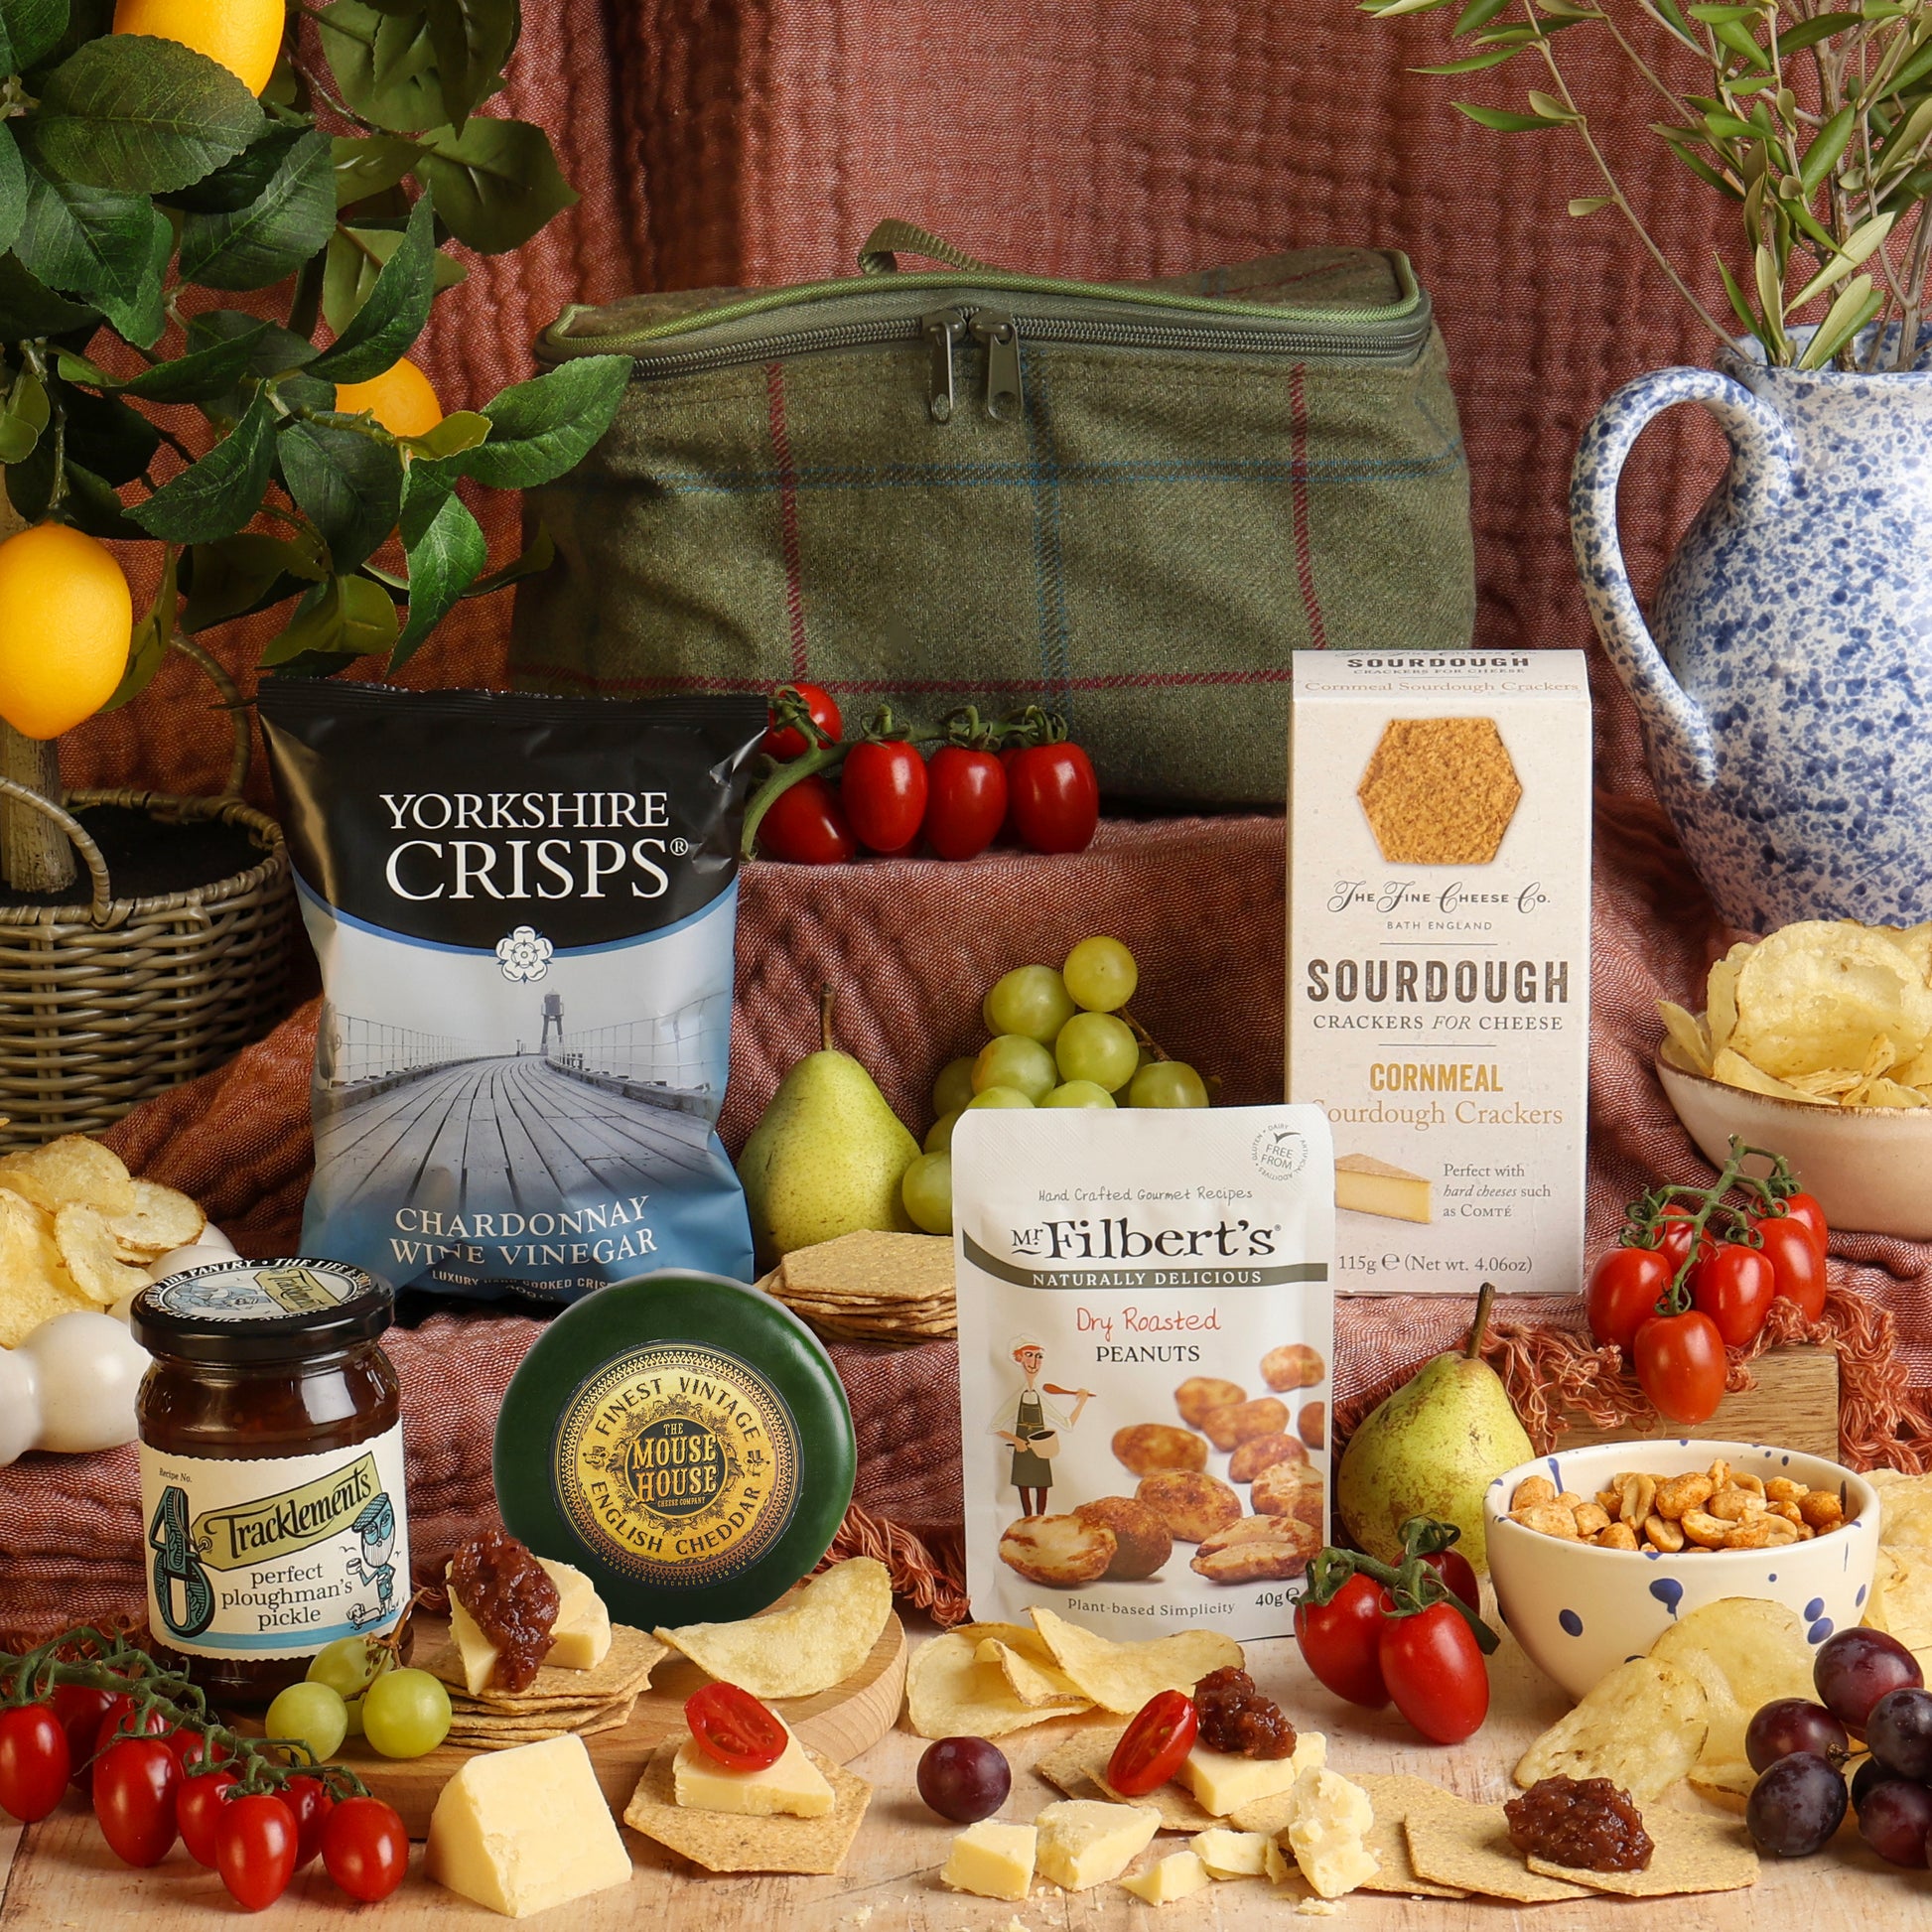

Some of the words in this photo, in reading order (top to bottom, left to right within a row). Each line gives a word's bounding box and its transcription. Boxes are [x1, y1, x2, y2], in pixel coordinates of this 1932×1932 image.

[1347, 657, 1530, 668] SOURDOUGH
[1305, 681, 1392, 692] Cornmeal
[1398, 681, 1495, 693] Sourdough
[1501, 680, 1580, 692] Crackers
[379, 792, 670, 830] YORKSHIRE
[1387, 921, 1421, 930] BATH
[1428, 921, 1492, 930] ENGLAND
[1307, 958, 1569, 1004] SOURDOUGH
[1313, 1015, 1424, 1030] CRACKERS
[1432, 1016, 1471, 1031] FOR
[1478, 1016, 1564, 1031] CHEESE
[1369, 1062, 1504, 1092] CORNMEAL
[1454, 1101, 1564, 1125] Crackers
[1251, 1133, 1263, 1161] GLUTEN
[1265, 1143, 1294, 1160] FREE
[1261, 1153, 1293, 1171] FROM
[1444, 1164, 1490, 1177] Perfect
[1495, 1164, 1525, 1177] with
[1038, 1187, 1069, 1202] Hand
[1074, 1188, 1132, 1201] Crafted
[1137, 1187, 1190, 1201] Gourmet
[1196, 1185, 1253, 1206] Recipes
[1444, 1184, 1472, 1197] hard
[1476, 1184, 1517, 1197] cheeses
[1520, 1184, 1551, 1197] such
[396, 1195, 649, 1238] CHARDONNAY
[1443, 1206, 1456, 1217] as
[390, 1238, 484, 1266] WINE
[497, 1228, 658, 1267] VINEGAR
[191, 1259, 255, 1277] PANTRY
[274, 1258, 312, 1268] THE
[314, 1260, 348, 1273] LIFE
[1338, 1255, 1377, 1273] 115g
[1404, 1253, 1441, 1272] (Net
[1445, 1261, 1469, 1272] wt.
[1474, 1257, 1533, 1273] 4.06oz)
[432, 1270, 479, 1287] LUXURY
[1033, 1273, 1147, 1287] NATURALLY
[1155, 1272, 1262, 1285] DELICIOUS
[1077, 1307, 1113, 1341] Dry
[1122, 1307, 1222, 1332] Roasted
[1096, 1346, 1200, 1362] PEANUTS
[596, 1377, 662, 1437] FINEST
[679, 1376, 761, 1443] VINTAGE
[663, 1423, 684, 1436] THE
[631, 1434, 717, 1470] MOUSE
[159, 1467, 180, 1480] Recipe
[180, 1471, 193, 1483] No.
[635, 1464, 717, 1503] HOUSE
[204, 1460, 372, 1559] Tracklements
[657, 1498, 679, 1508] CHEESE
[679, 1496, 706, 1506] COMPANY
[591, 1481, 663, 1553] ENGLISH
[675, 1486, 760, 1556] CHEDDAR
[251, 1563, 324, 1588] perfect
[221, 1579, 353, 1609] ploughman's
[1255, 1591, 1284, 1606] 40g
[1067, 1597, 1155, 1616] Plant-based
[1160, 1601, 1235, 1618] Simplicity
[257, 1607, 322, 1631] pickle
